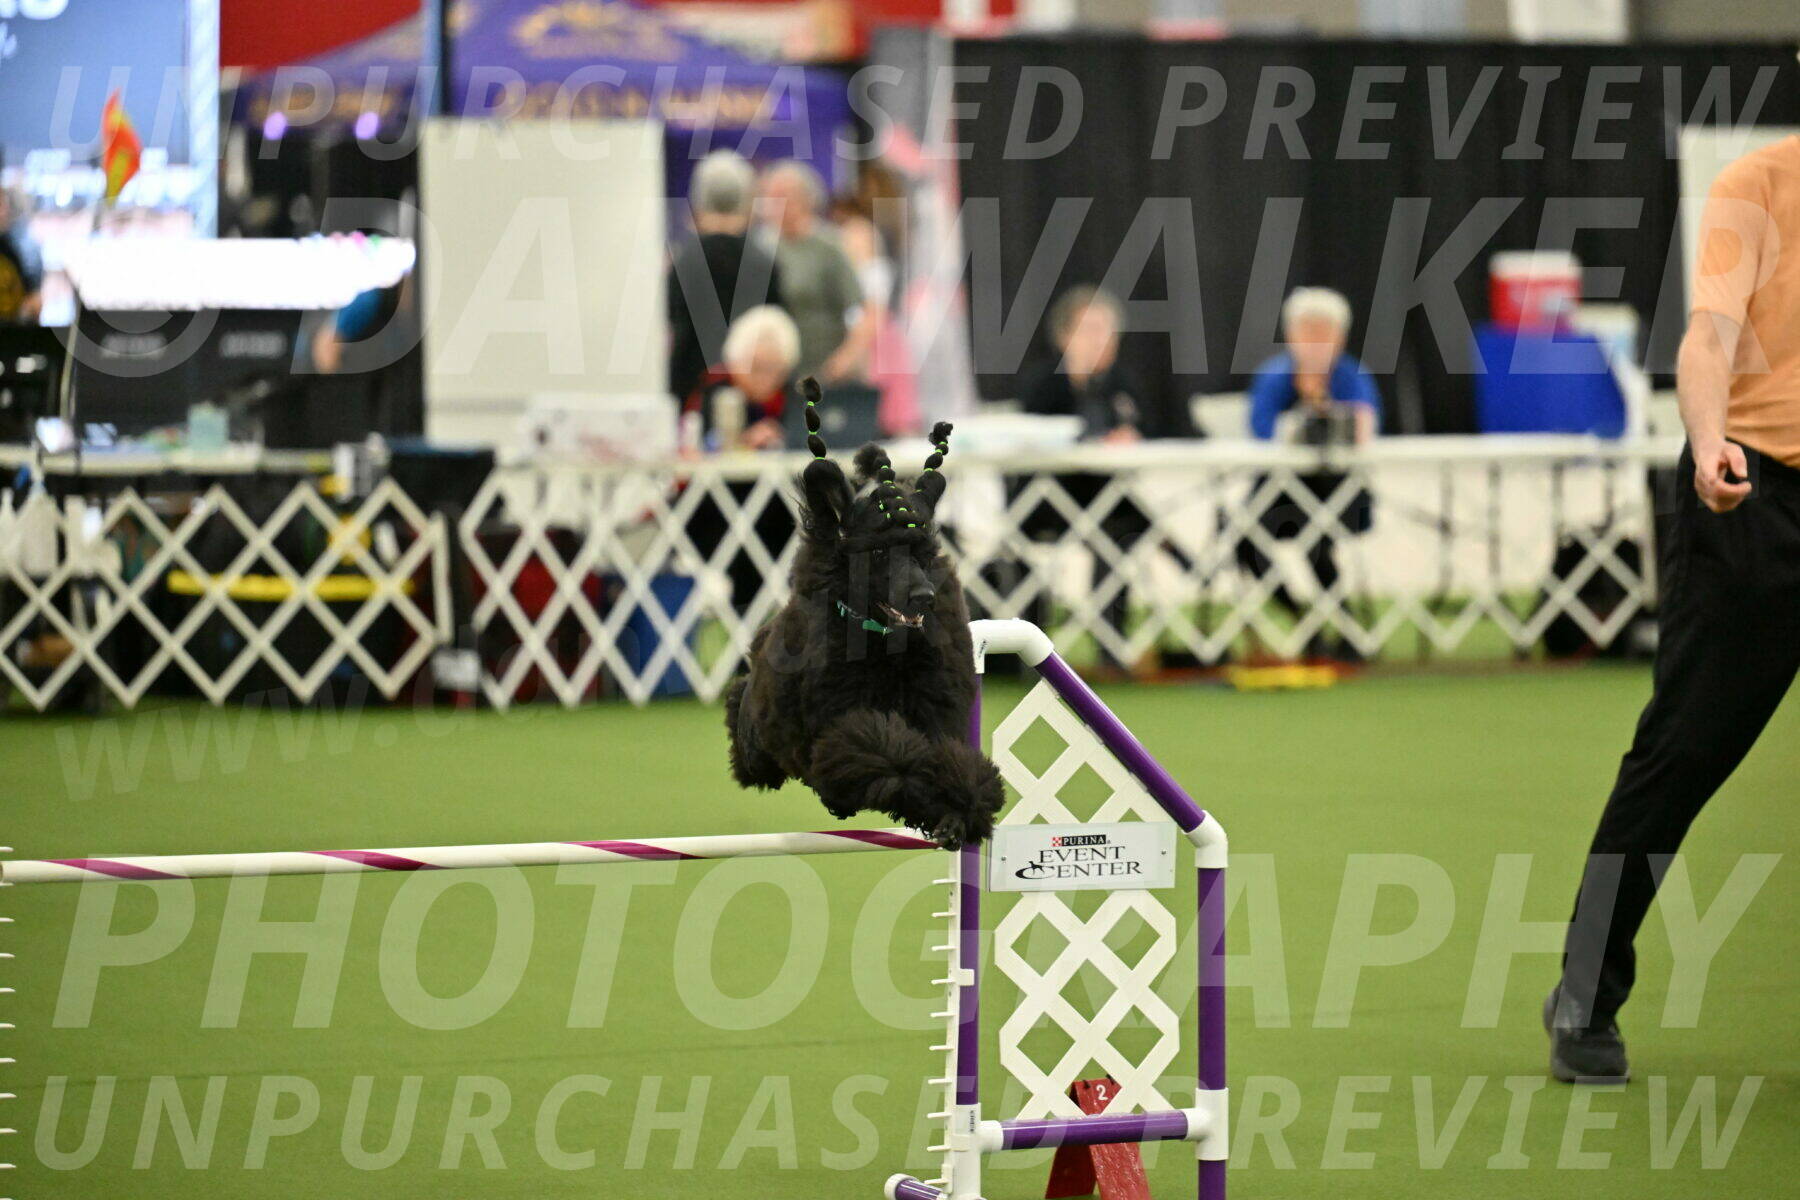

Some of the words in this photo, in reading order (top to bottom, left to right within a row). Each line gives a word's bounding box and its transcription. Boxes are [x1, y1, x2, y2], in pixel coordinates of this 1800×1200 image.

[1063, 836, 1105, 847] PURINA
[1040, 846, 1126, 863] EVENT
[1015, 861, 1143, 879] CENTER
[1096, 1084, 1109, 1101] 2
